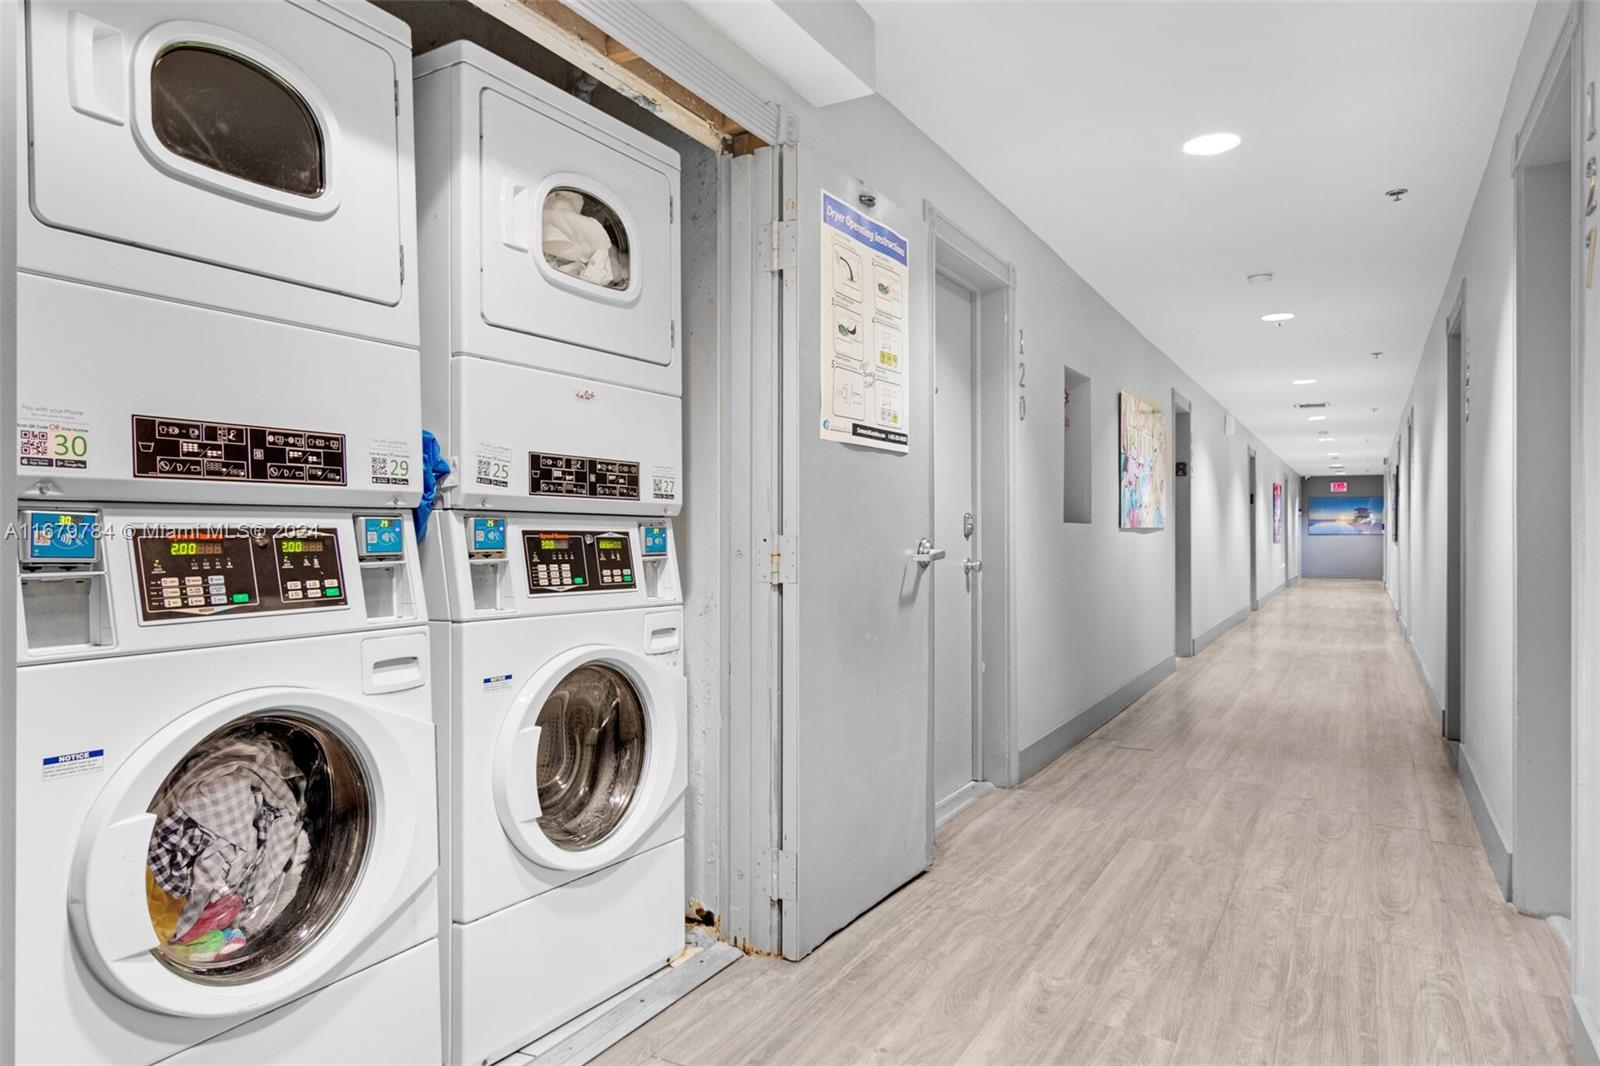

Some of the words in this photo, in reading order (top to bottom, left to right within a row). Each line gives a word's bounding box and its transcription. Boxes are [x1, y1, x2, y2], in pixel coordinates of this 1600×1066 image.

[827, 204, 845, 225] Dryer
[845, 214, 874, 243] Operating
[1018, 329, 1026, 422] 120
[54, 433, 88, 457] 30
[390, 459, 409, 477] 29
[493, 462, 509, 479] 25
[664, 480, 675, 493] 27
[59, 515, 72, 525] 30
[58, 752, 90, 763] NOTICE
